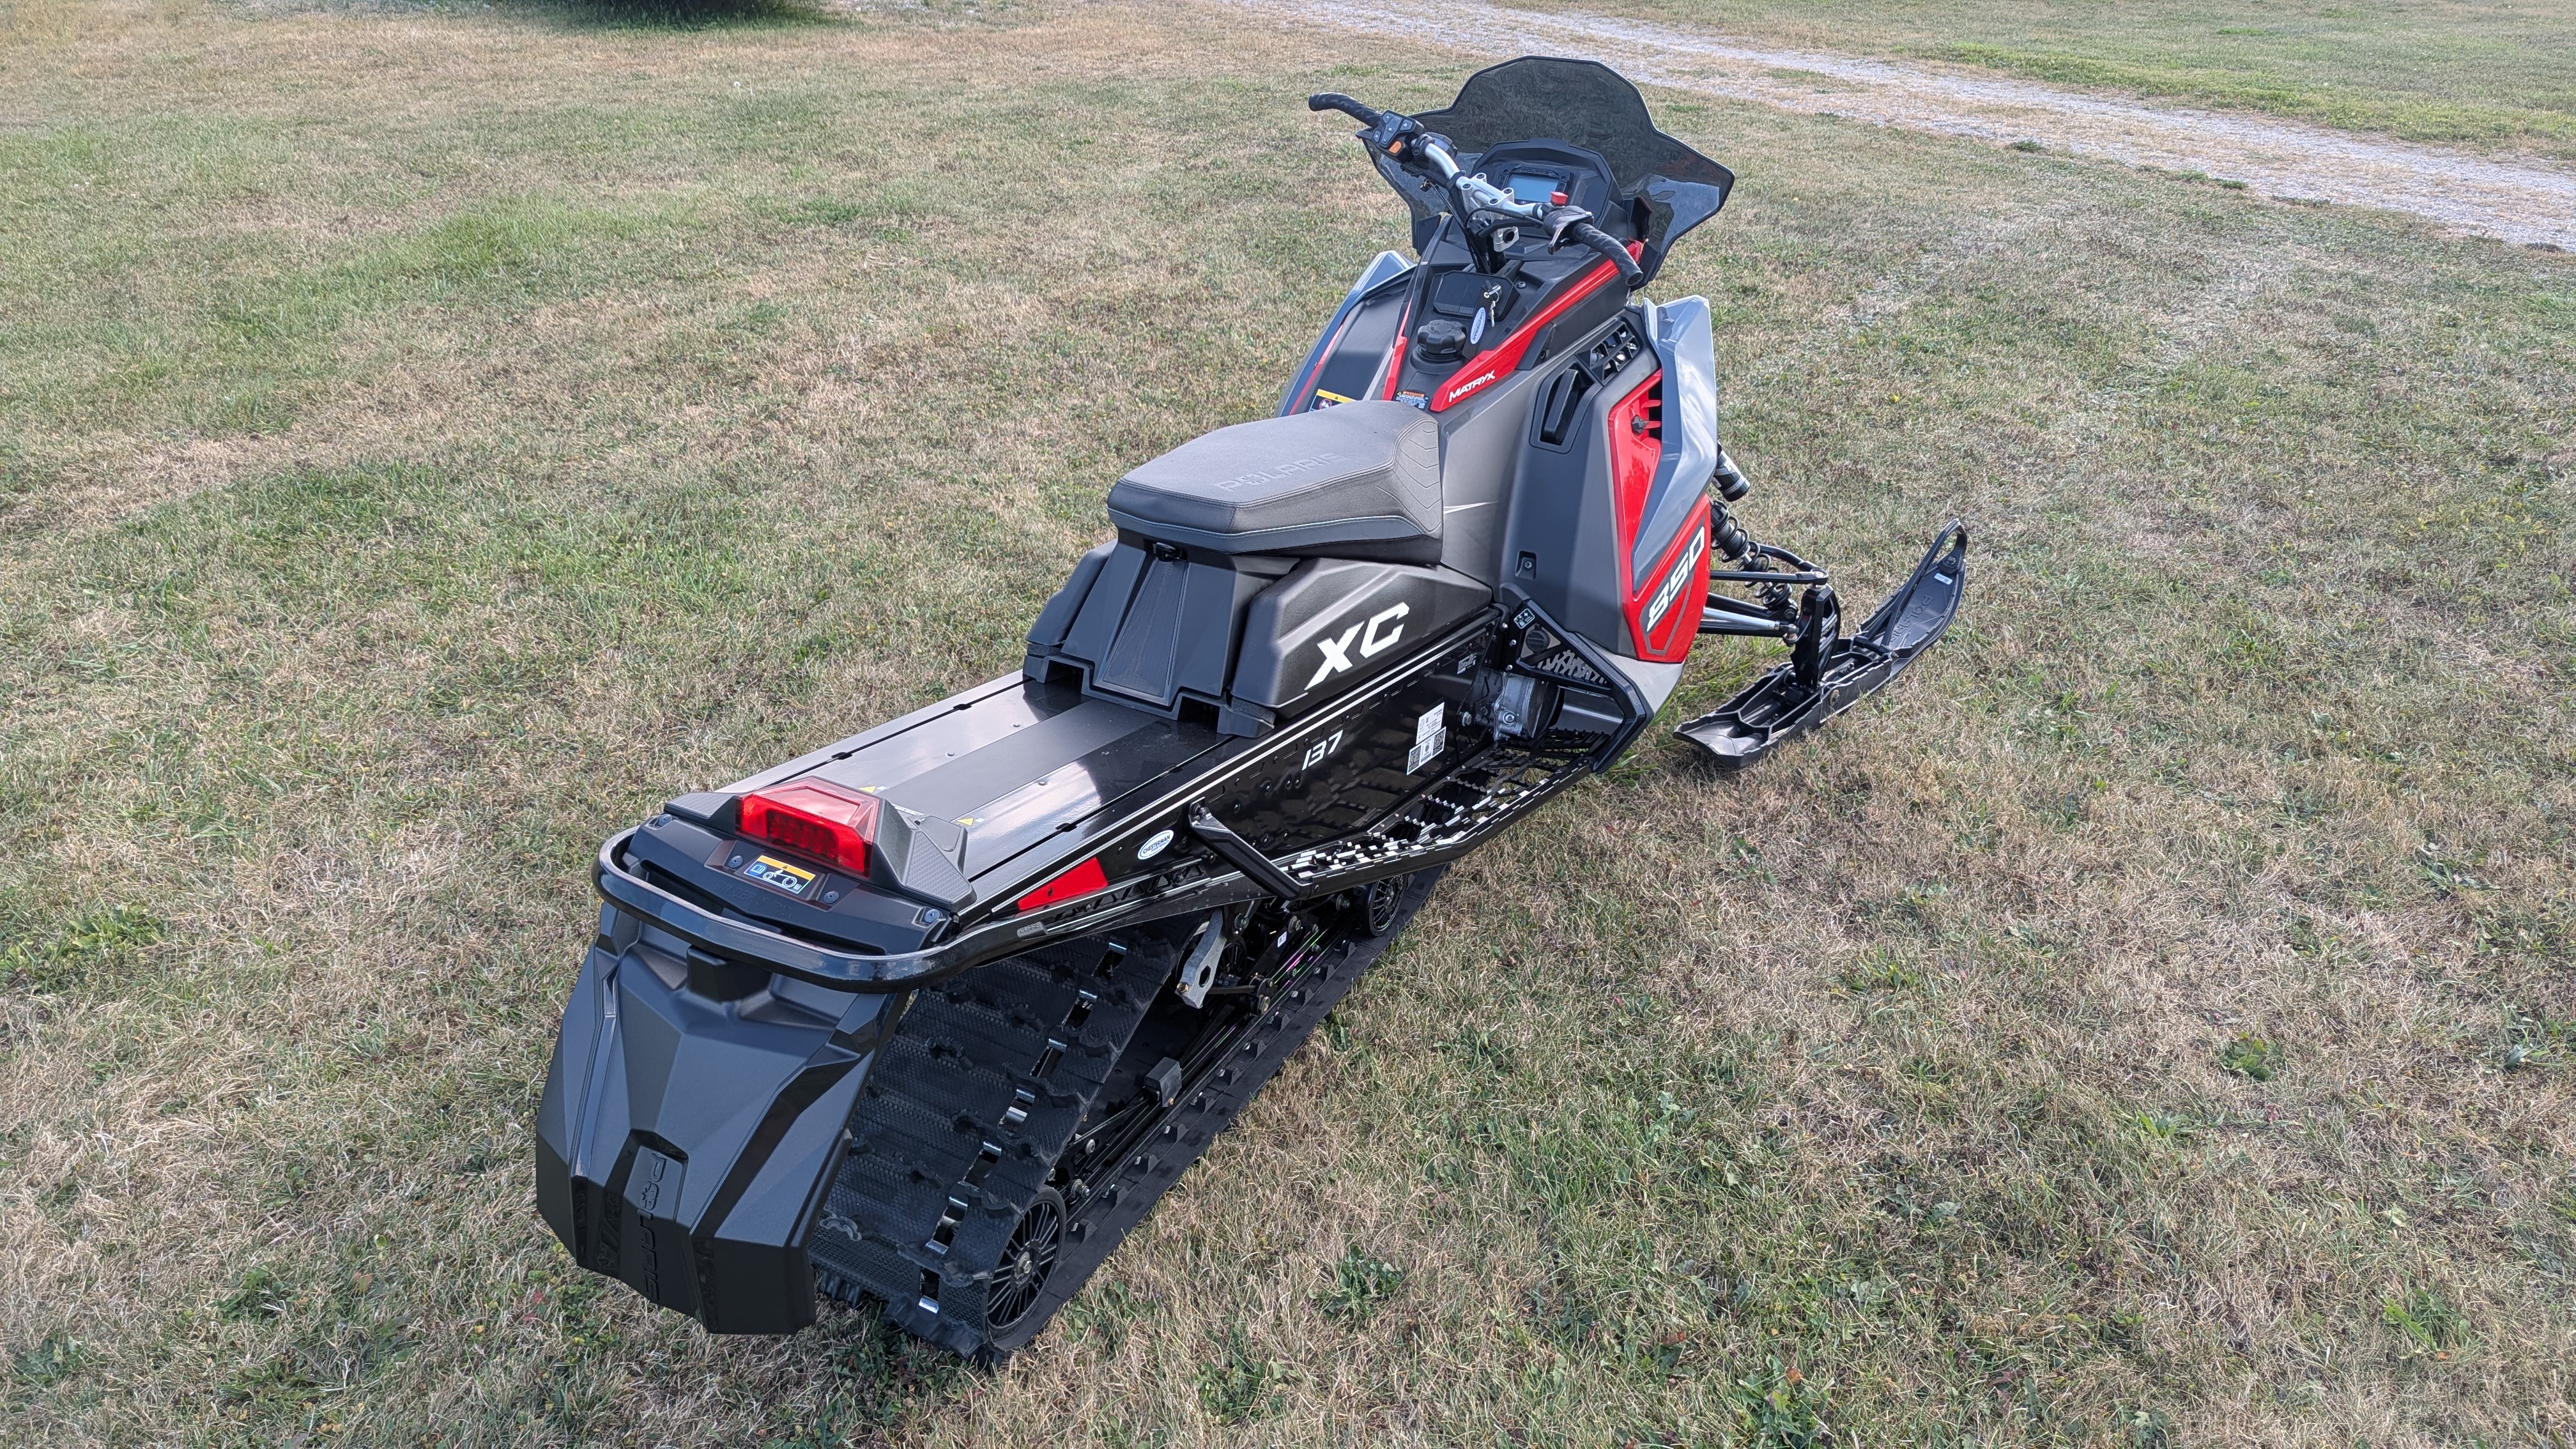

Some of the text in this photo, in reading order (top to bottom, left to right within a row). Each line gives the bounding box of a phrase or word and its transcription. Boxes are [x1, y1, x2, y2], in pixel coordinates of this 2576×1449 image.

[1449, 370, 1496, 402] MATRYX
[1211, 452, 1349, 491] POLARIS
[1646, 526, 1705, 632] 850
[1304, 602, 1409, 691] XC
[1301, 730, 1344, 770] 137
[1143, 834, 1170, 854] CHESTERMAN
[637, 1153, 667, 1301] POLARIS
